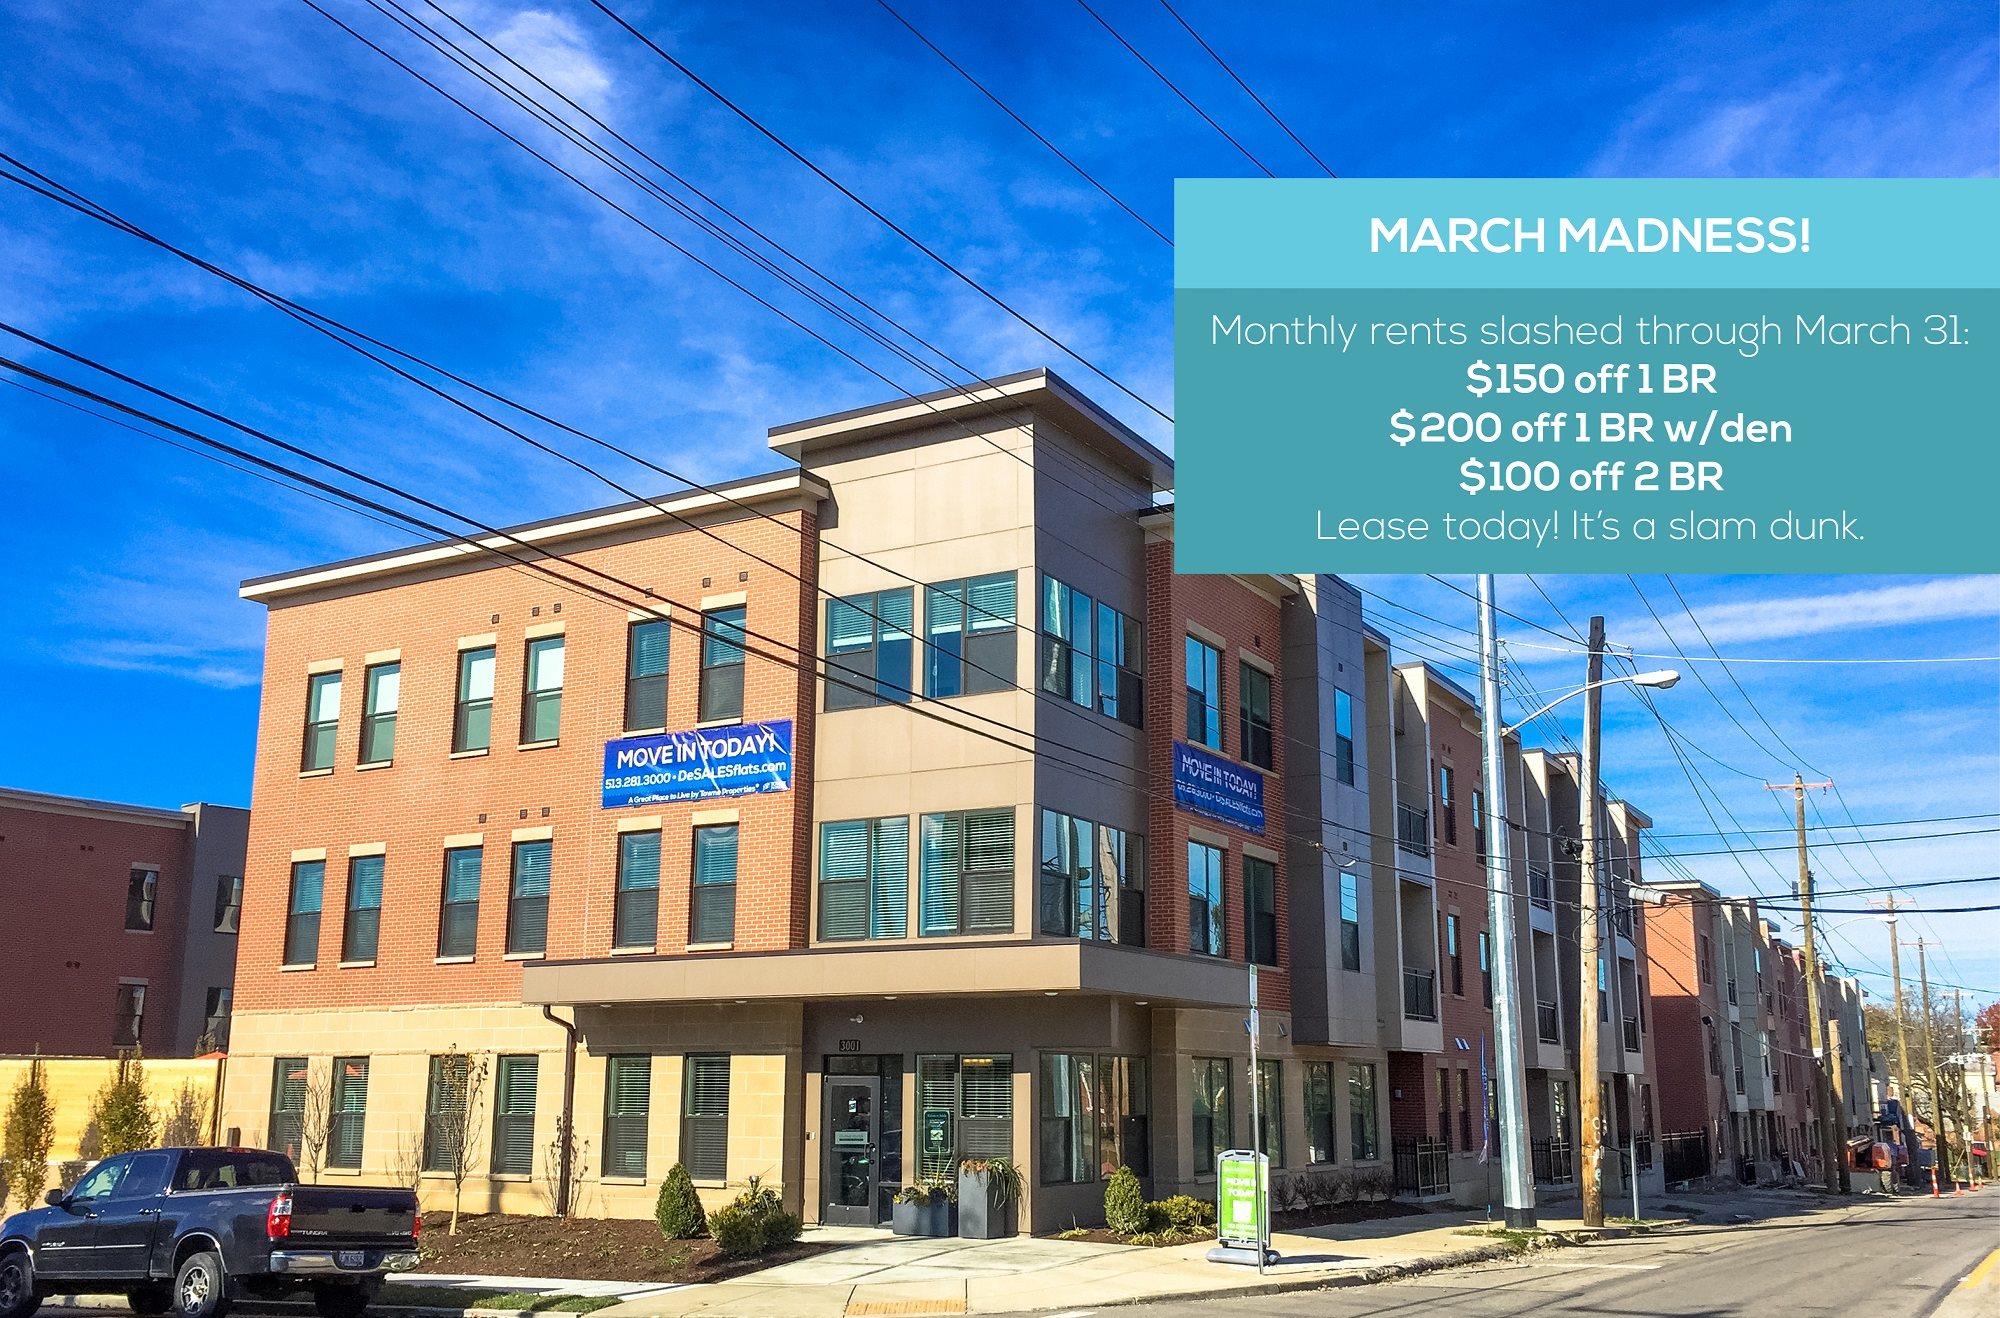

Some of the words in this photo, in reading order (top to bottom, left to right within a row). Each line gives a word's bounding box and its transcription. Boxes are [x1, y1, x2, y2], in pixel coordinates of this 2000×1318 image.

[617, 745, 674, 769] MOVE
[677, 742, 697, 763] IN
[700, 733, 776, 760] TODAY!
[605, 772, 671, 790] 513.281.3000
[677, 761, 787, 782] DeSALESflats.com
[1182, 754, 1213, 782] MOVE
[1223, 771, 1257, 800] TODAY!
[634, 795, 651, 804] Great
[652, 793, 669, 802] Place
[840, 1040, 859, 1051] 3001
